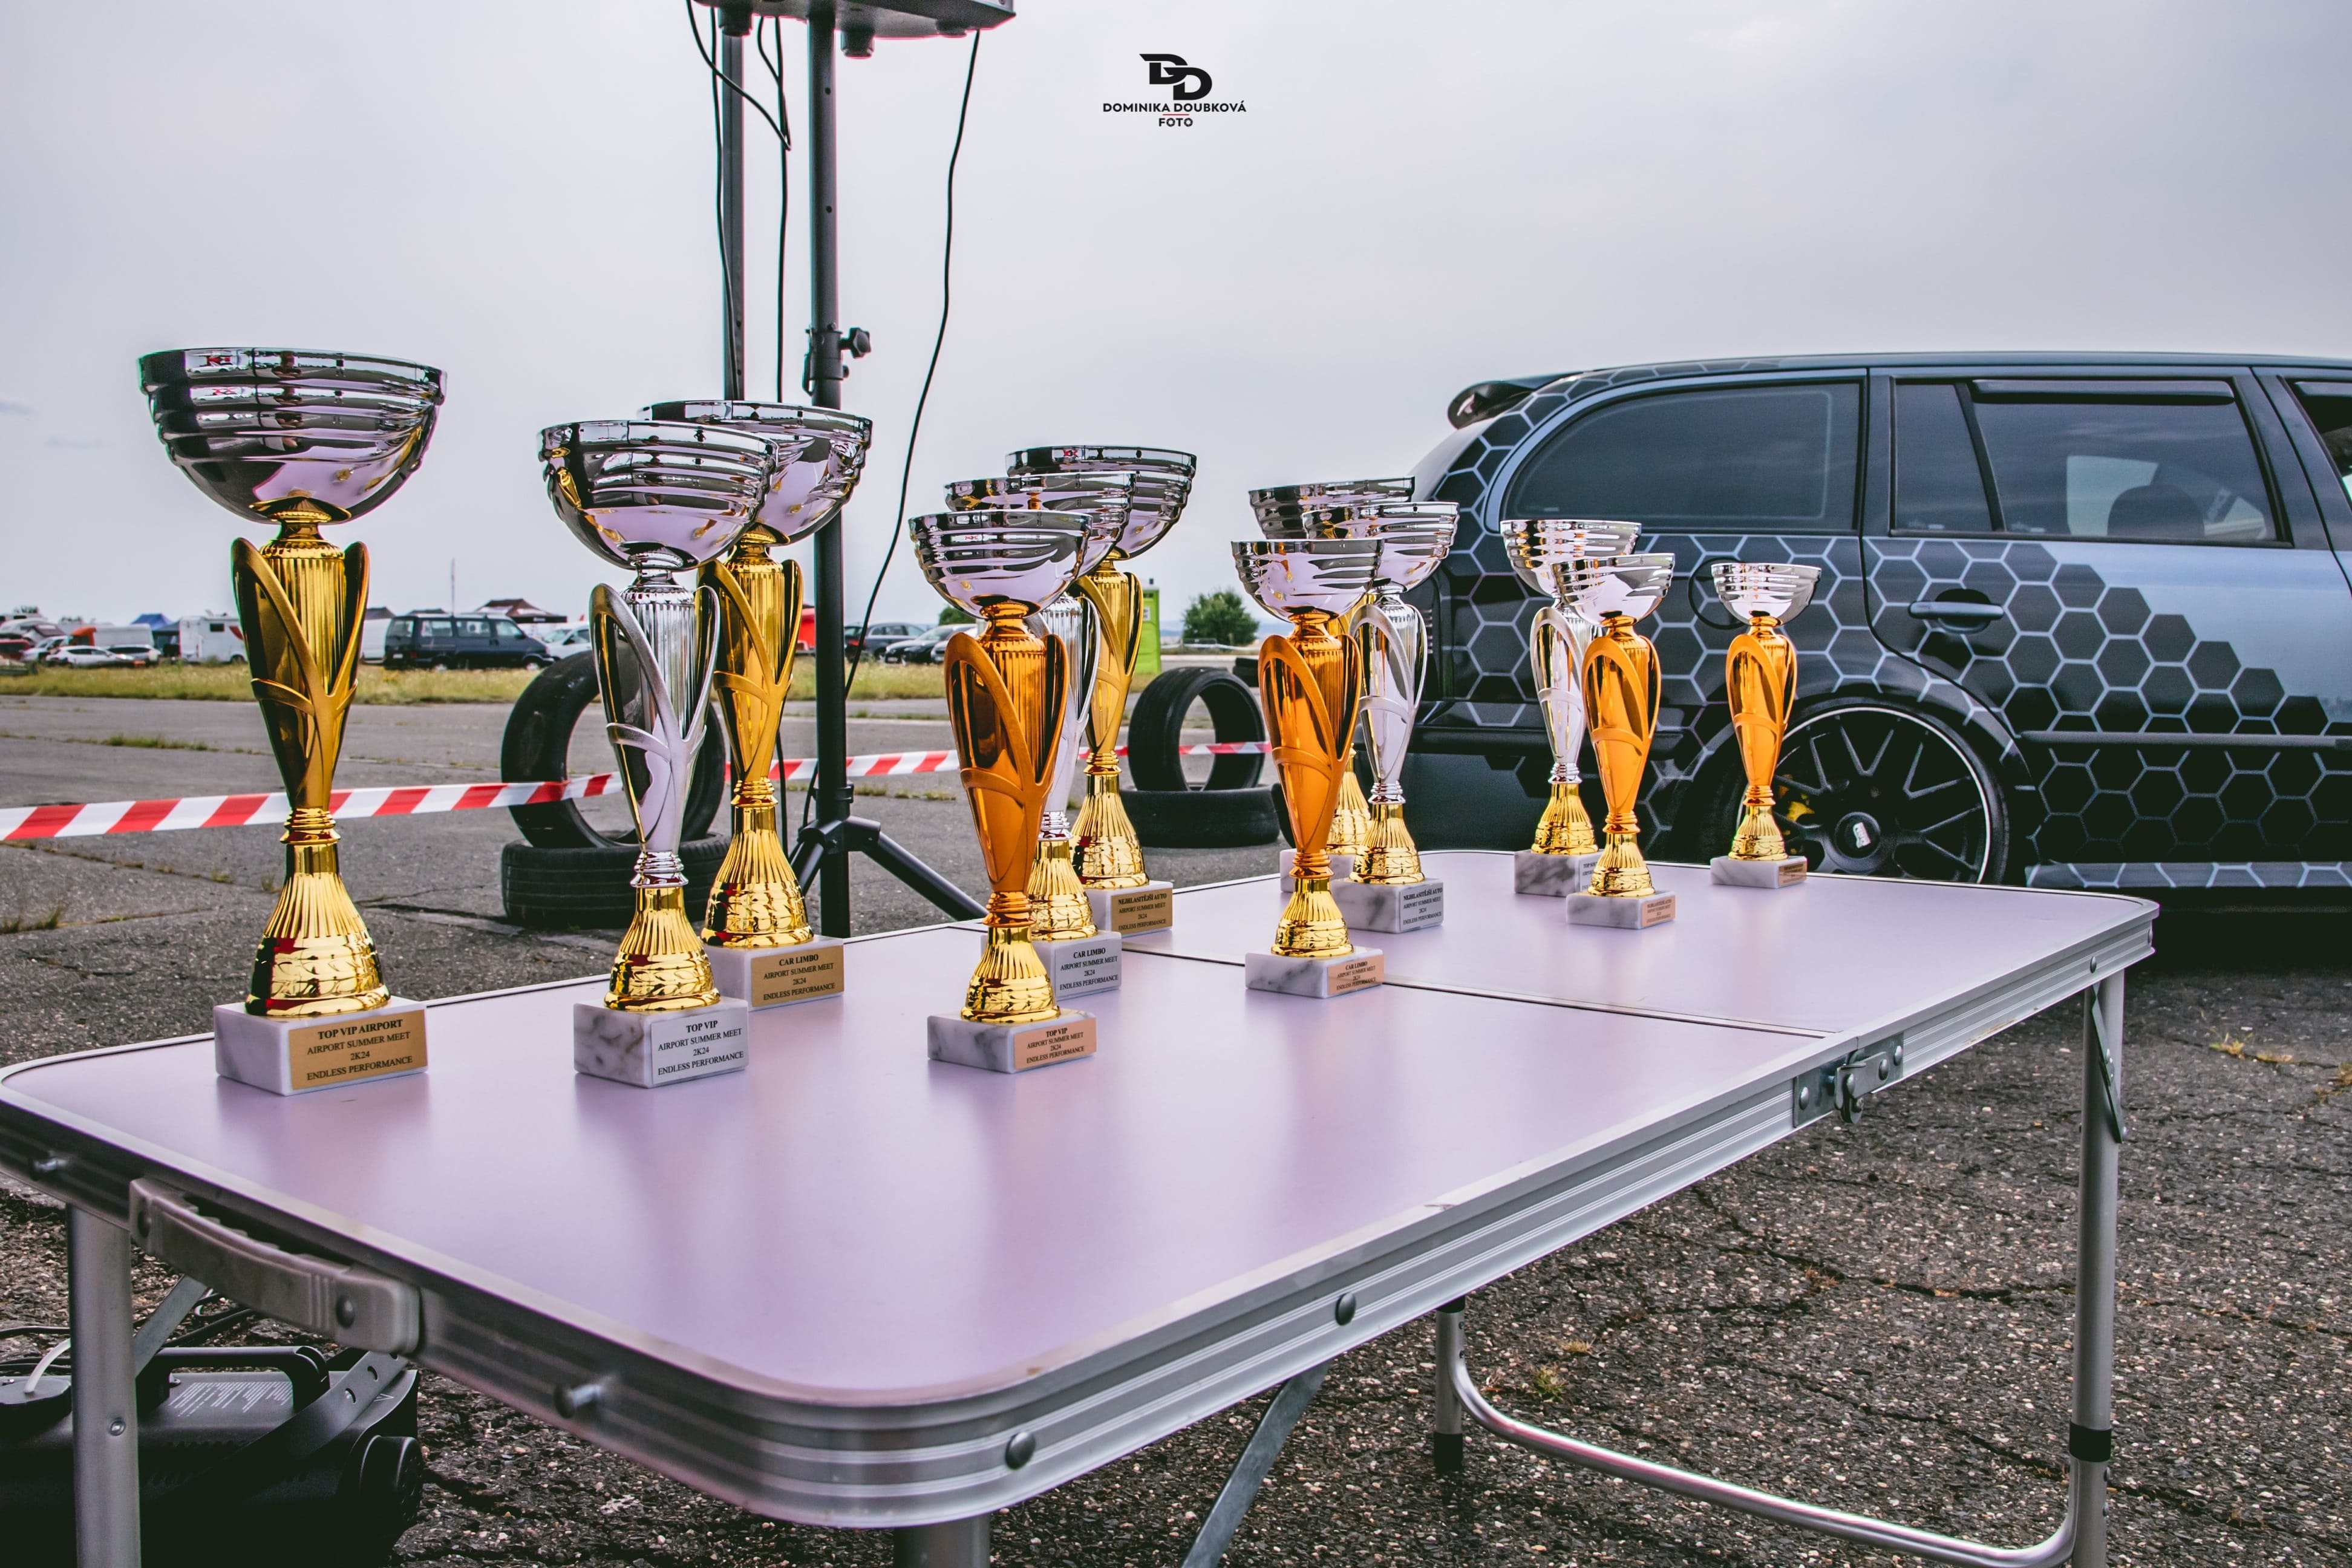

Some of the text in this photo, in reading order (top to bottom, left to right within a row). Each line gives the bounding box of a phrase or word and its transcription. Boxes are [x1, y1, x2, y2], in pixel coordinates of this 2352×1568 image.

[1137, 919, 1166, 928] PERFORMANCE
[1074, 947, 1106, 958] CAR LIMBO
[779, 954, 818, 966] CAR LIMBO
[1060, 962, 1081, 971] AIRPORT
[1082, 959, 1103, 967] SUMMER
[764, 970, 789, 979] AIRPORT
[791, 967, 816, 975] SUMMER
[1060, 975, 1118, 990] ENDLESS PERFORMANCE
[763, 983, 835, 1001] ENDLESS PERFORMANCE
[318, 1019, 403, 1040] TOP VIP AIRPORT
[686, 1020, 718, 1033] TOP VIP
[658, 1028, 742, 1051] AIRPORT SUMMER MEET
[1046, 1030, 1058, 1038] TOP
[307, 1031, 411, 1055] AIRPORT SUMMER MEET
[1027, 1039, 1048, 1049] AIRPORT
[1049, 1036, 1070, 1045] SUMMER
[350, 1051, 370, 1060] 2K24
[693, 1047, 709, 1056] 2K24
[1026, 1046, 1084, 1063] ENDLESS PERFORMANCE
[307, 1056, 413, 1080] ENDLESS PERFORMANCE
[658, 1051, 744, 1076] ENDLESS PERFORMANCE
